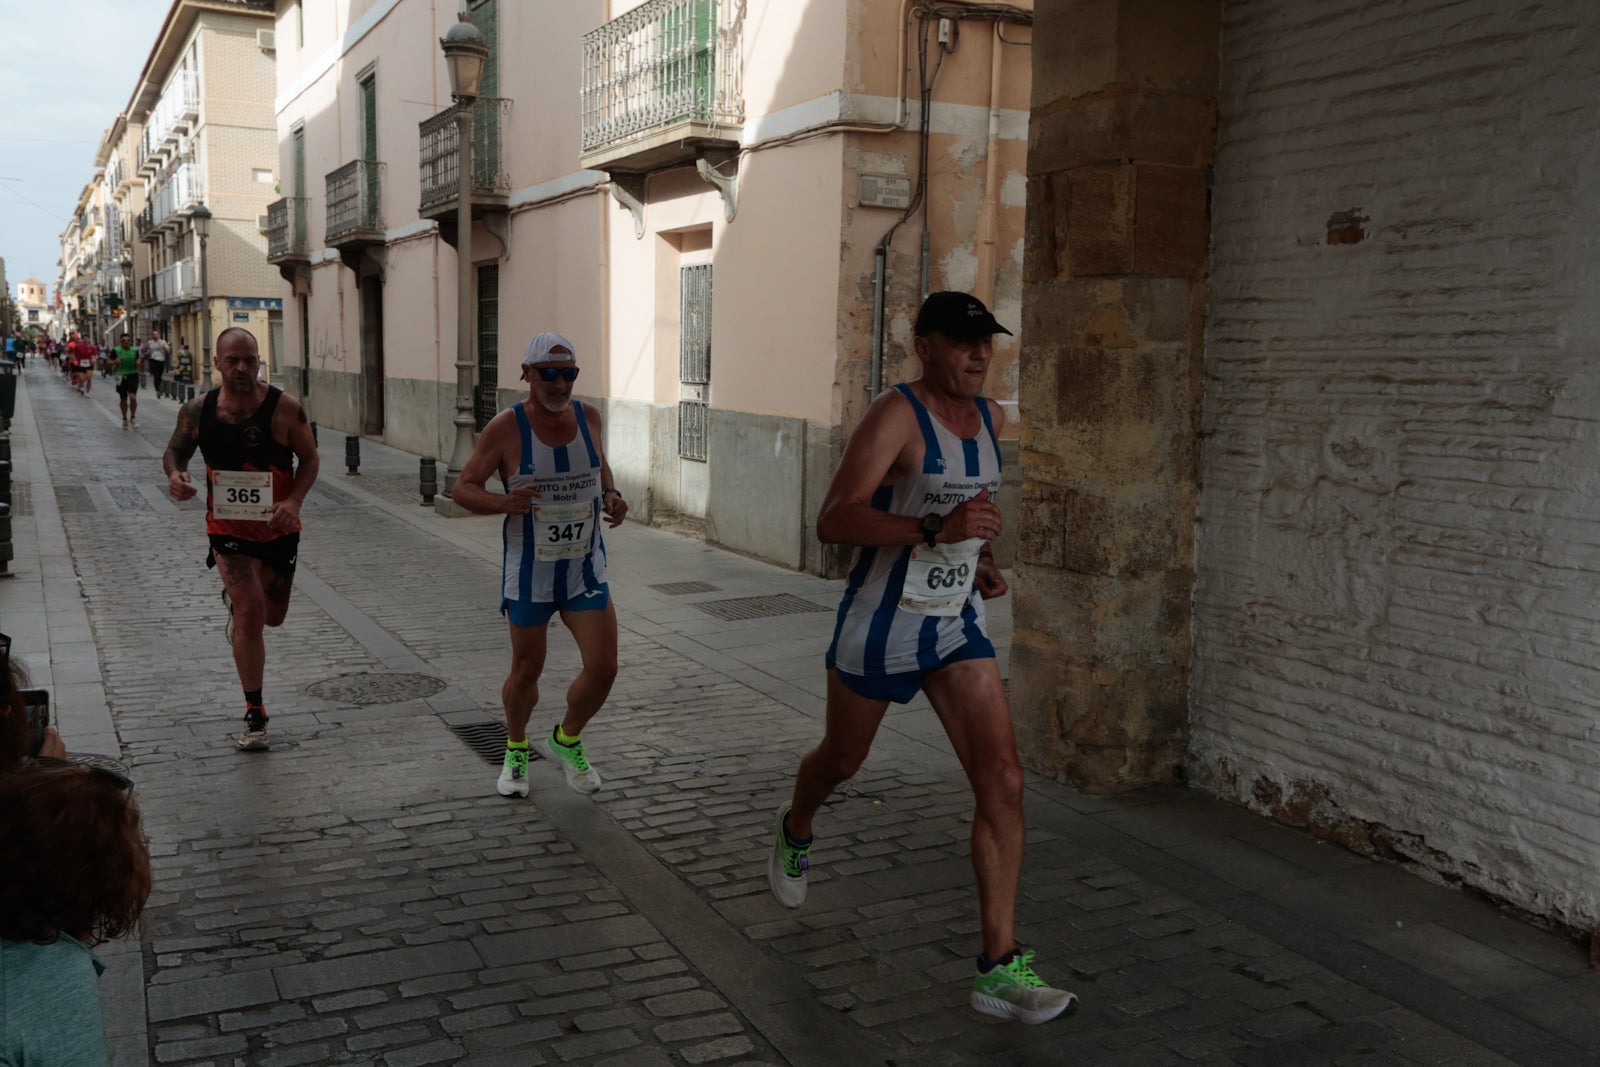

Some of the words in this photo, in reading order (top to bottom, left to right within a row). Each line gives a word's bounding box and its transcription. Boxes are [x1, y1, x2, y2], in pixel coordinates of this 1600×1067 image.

[536, 484, 559, 492] ZITO
[569, 478, 597, 490] PAZITO
[227, 488, 260, 503] 365
[553, 493, 577, 501] Motril
[924, 493, 965, 504] PAZITO
[548, 522, 585, 543] 347
